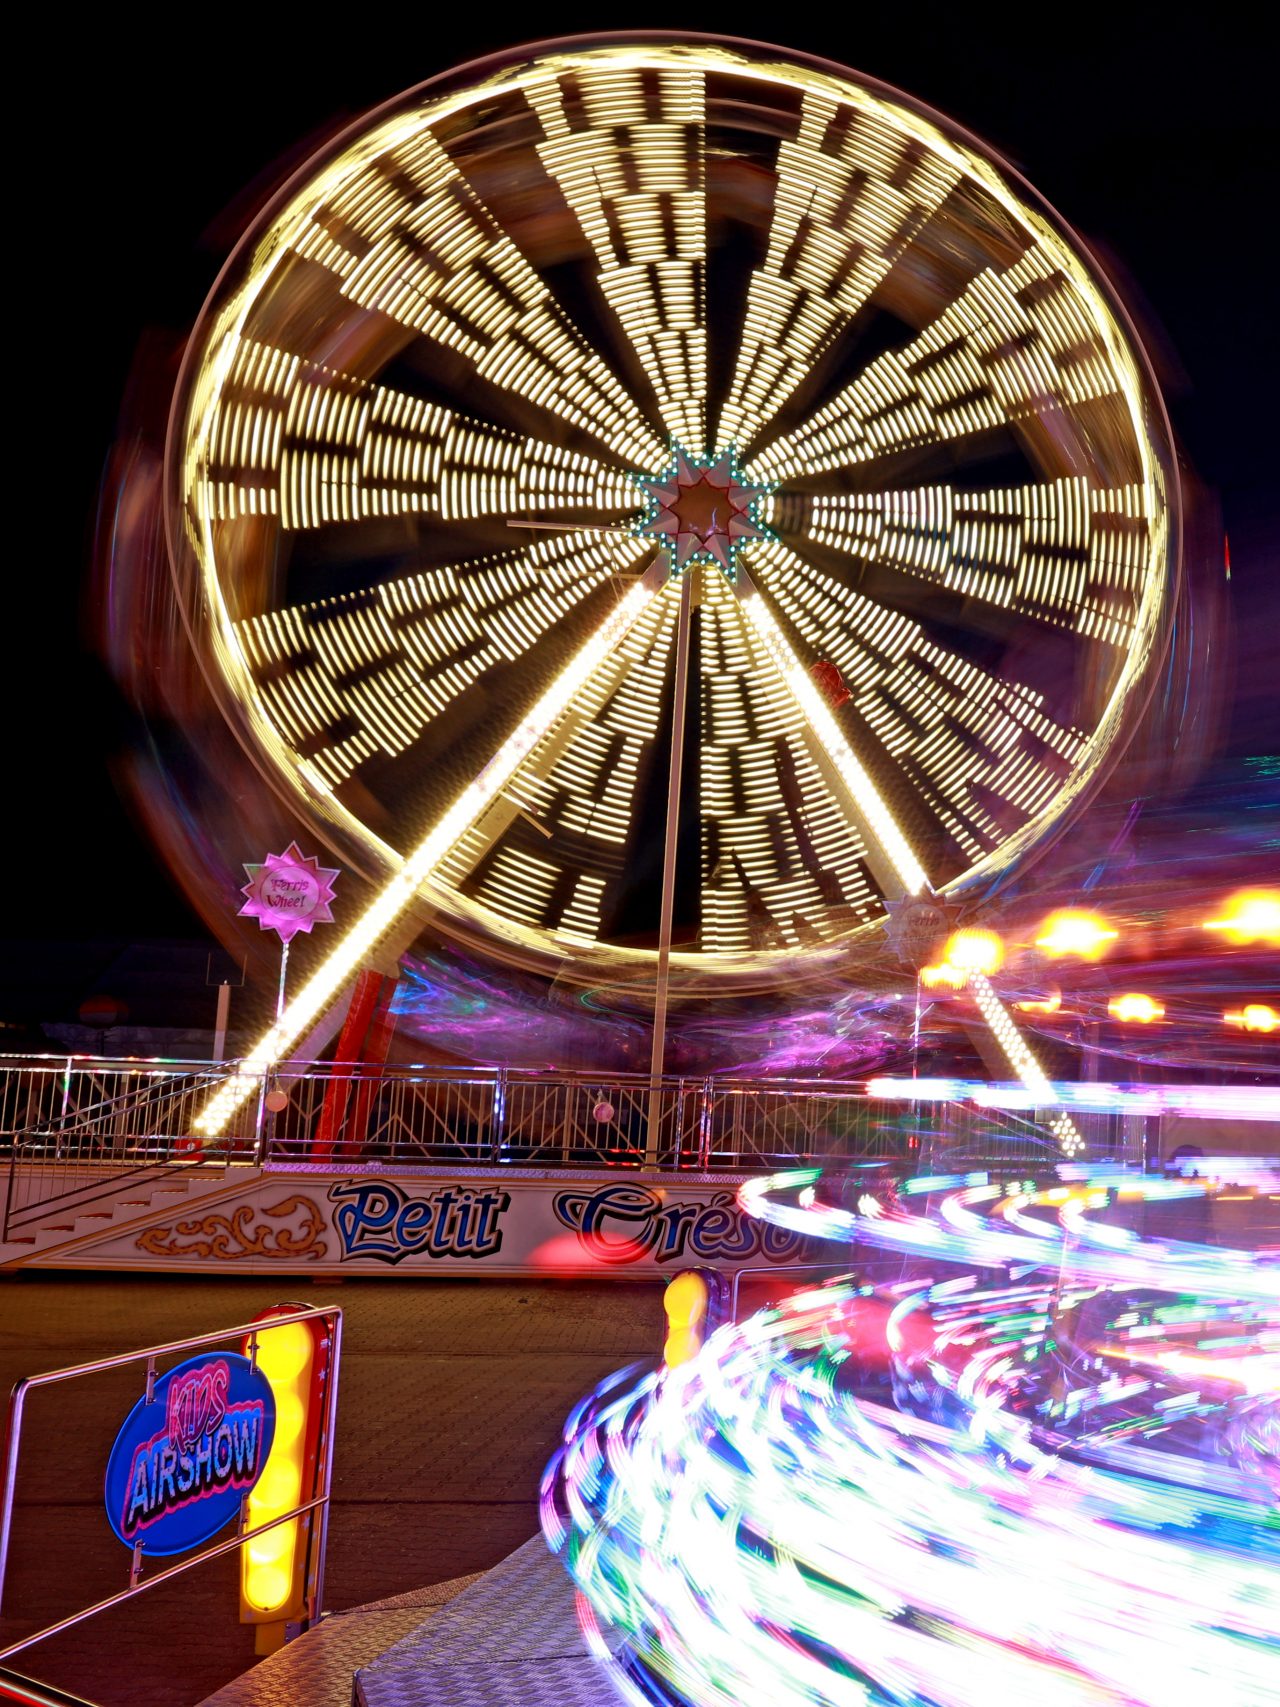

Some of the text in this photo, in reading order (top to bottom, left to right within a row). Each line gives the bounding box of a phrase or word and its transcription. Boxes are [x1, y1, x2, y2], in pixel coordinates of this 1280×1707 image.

[266, 895, 306, 908] Wheel
[271, 879, 309, 891] Ferris
[328, 1178, 817, 1265] Petit Créso
[168, 1366, 229, 1455] KIDS
[127, 1416, 260, 1527] AIRSHOW
